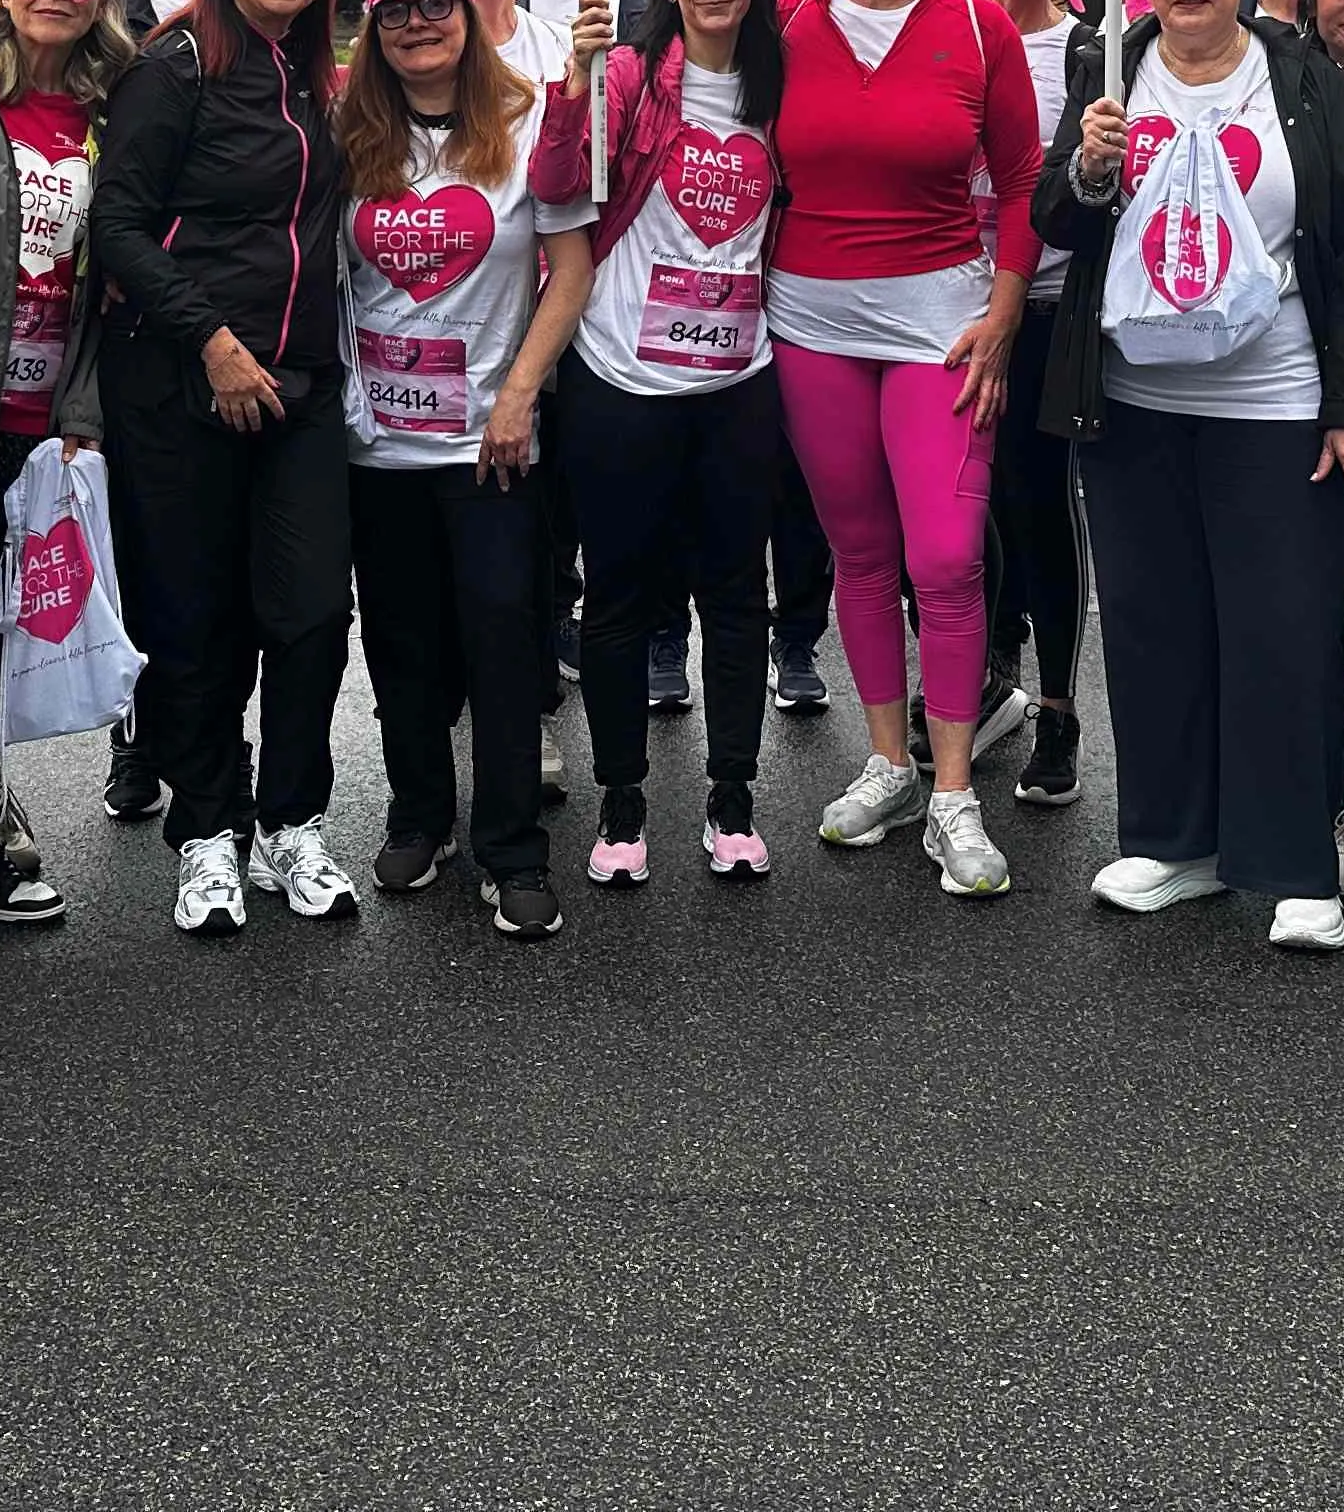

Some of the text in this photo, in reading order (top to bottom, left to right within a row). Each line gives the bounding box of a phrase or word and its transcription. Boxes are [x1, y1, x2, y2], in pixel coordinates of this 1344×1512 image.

[683, 144, 744, 173] RACE
[15, 171, 73, 198] ACE
[681, 166, 763, 200] FOR THE
[17, 192, 90, 229] OR THE
[678, 187, 738, 216] CURE
[18, 214, 64, 241] URE
[374, 208, 446, 228] RACE
[698, 214, 728, 231] 2026
[374, 230, 475, 250] FOR THE
[377, 251, 446, 272] CURE
[668, 321, 740, 349] 84431
[6, 357, 47, 382] 438
[368, 379, 440, 412] 84414
[26, 544, 67, 572] ACE
[21, 561, 84, 595] OR THE
[19, 586, 72, 619] CURE
